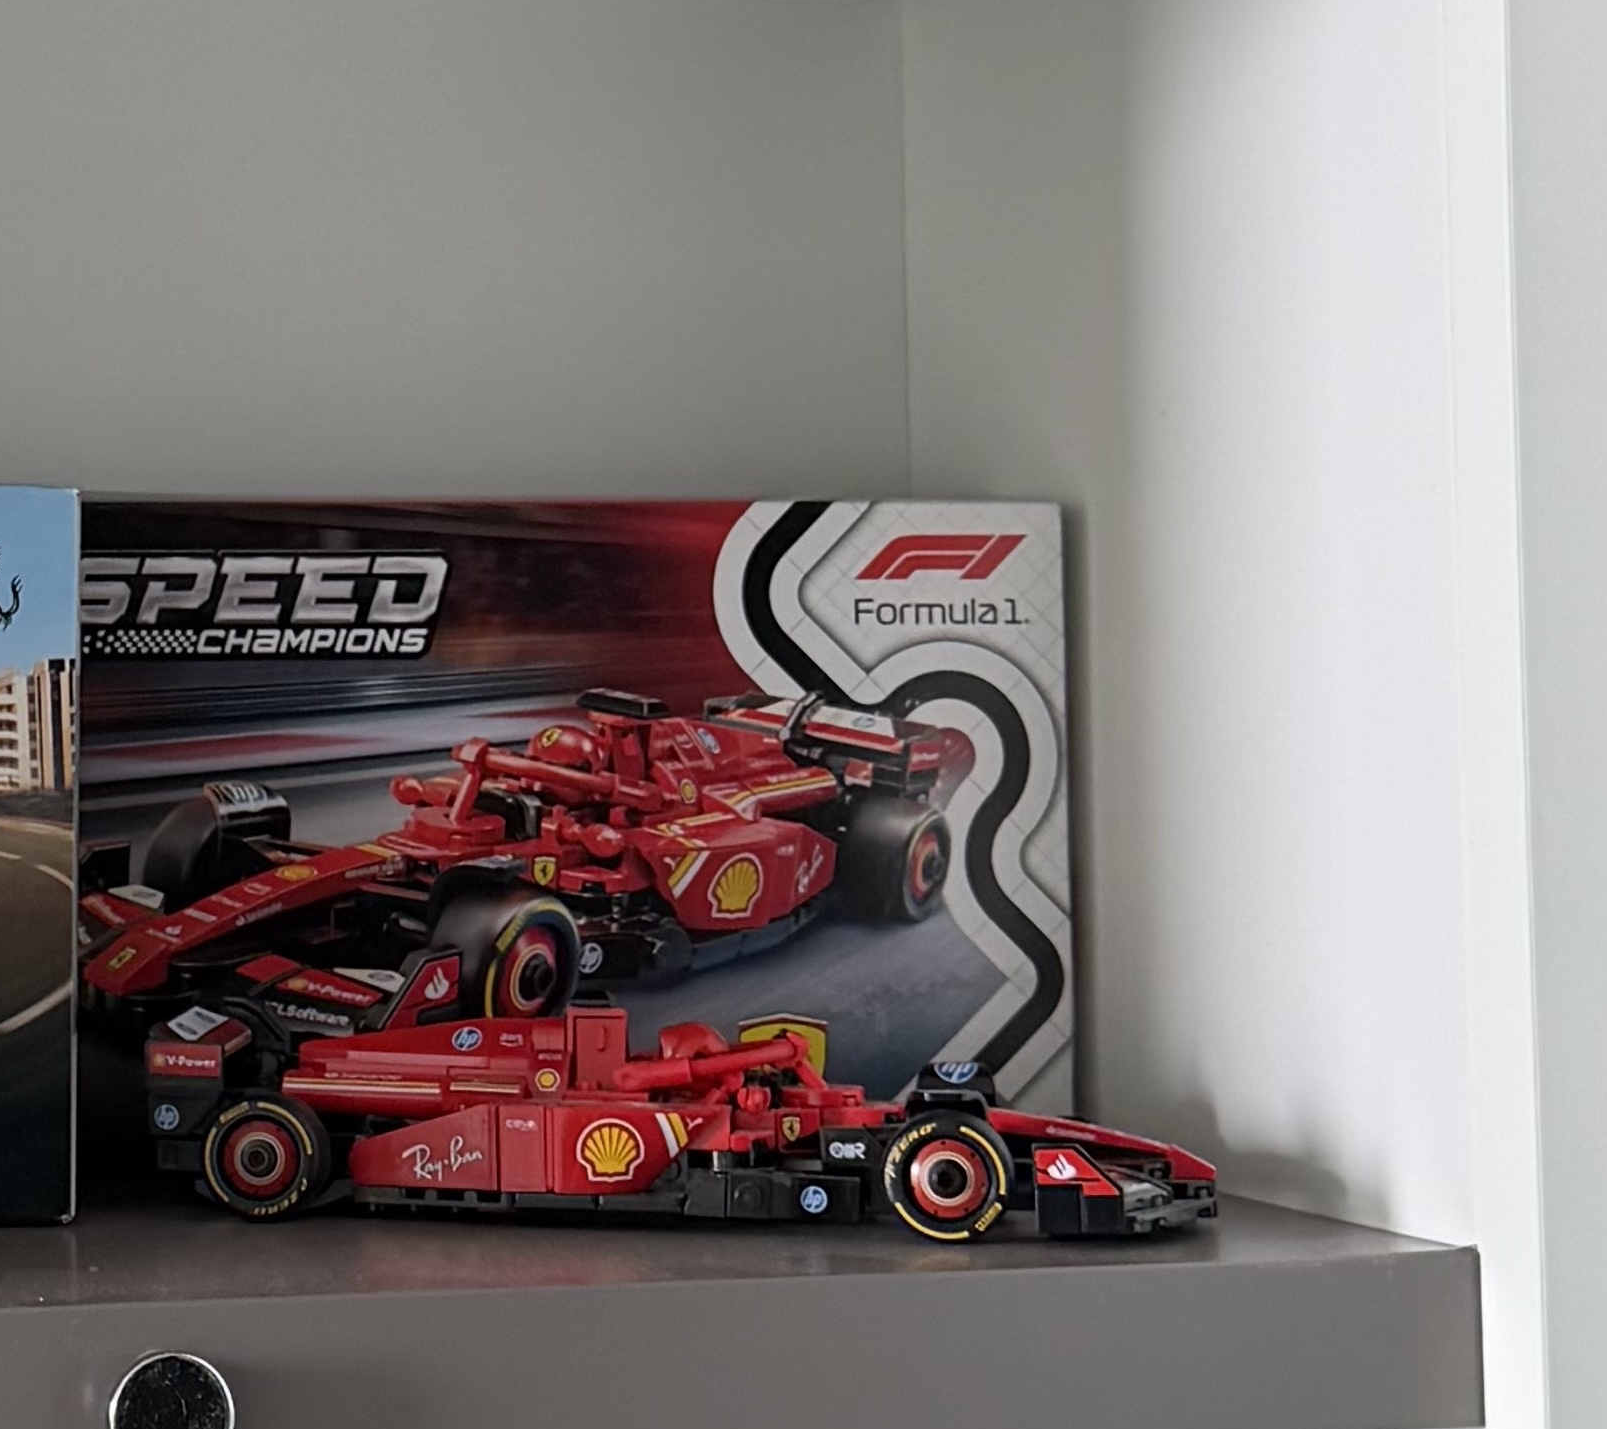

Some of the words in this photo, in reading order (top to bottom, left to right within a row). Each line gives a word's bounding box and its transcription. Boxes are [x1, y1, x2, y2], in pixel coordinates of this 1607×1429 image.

[80, 556, 448, 625] SPEED
[454, 1027, 481, 1051] hp
[166, 1055, 216, 1068] V-Power
